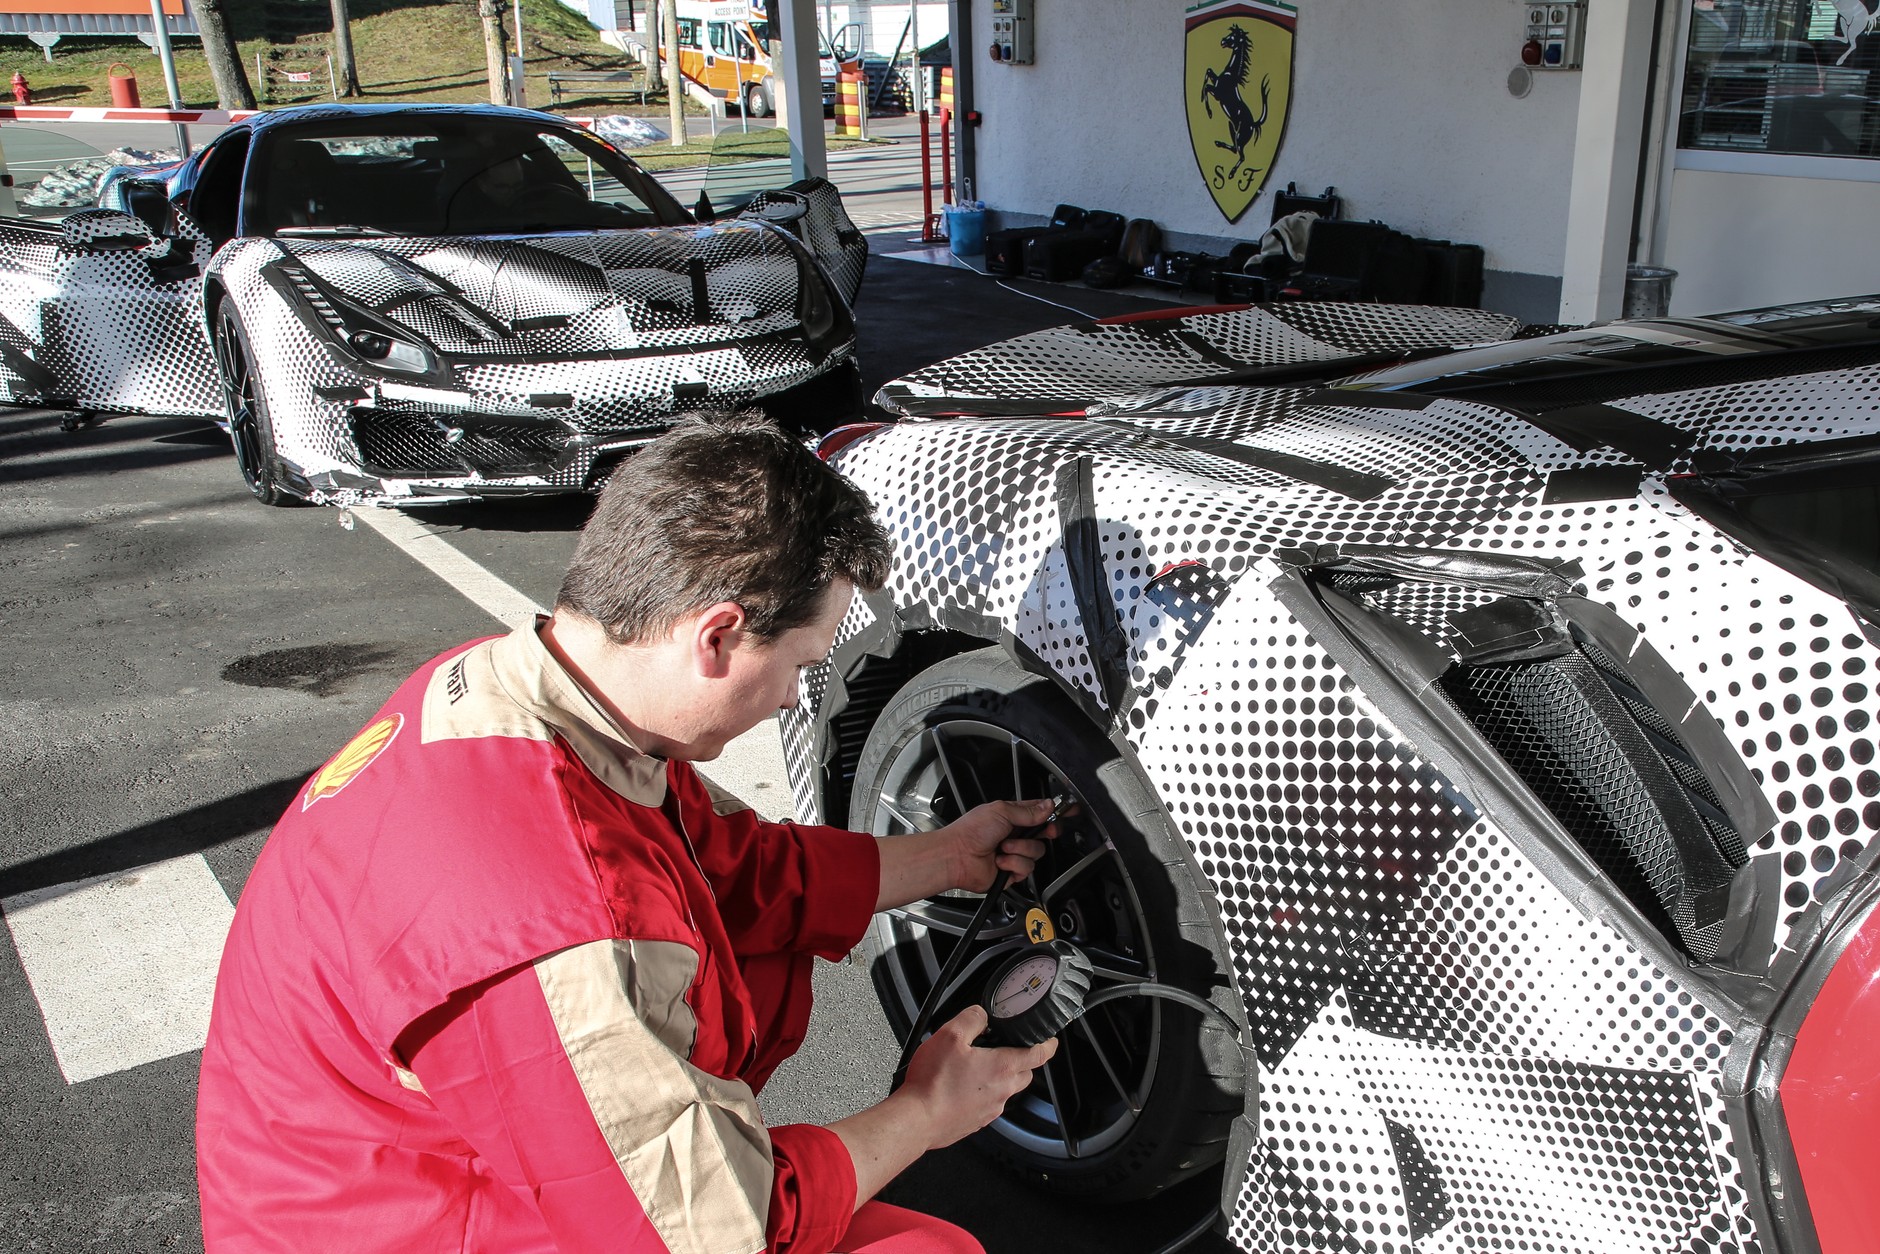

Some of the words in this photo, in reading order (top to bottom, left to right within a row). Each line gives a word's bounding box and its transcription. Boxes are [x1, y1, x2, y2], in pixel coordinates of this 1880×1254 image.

[715, 7, 731, 16] ACCESS
[733, 6, 747, 15] POINT
[1213, 164, 1225, 190] S
[1237, 167, 1263, 192] F
